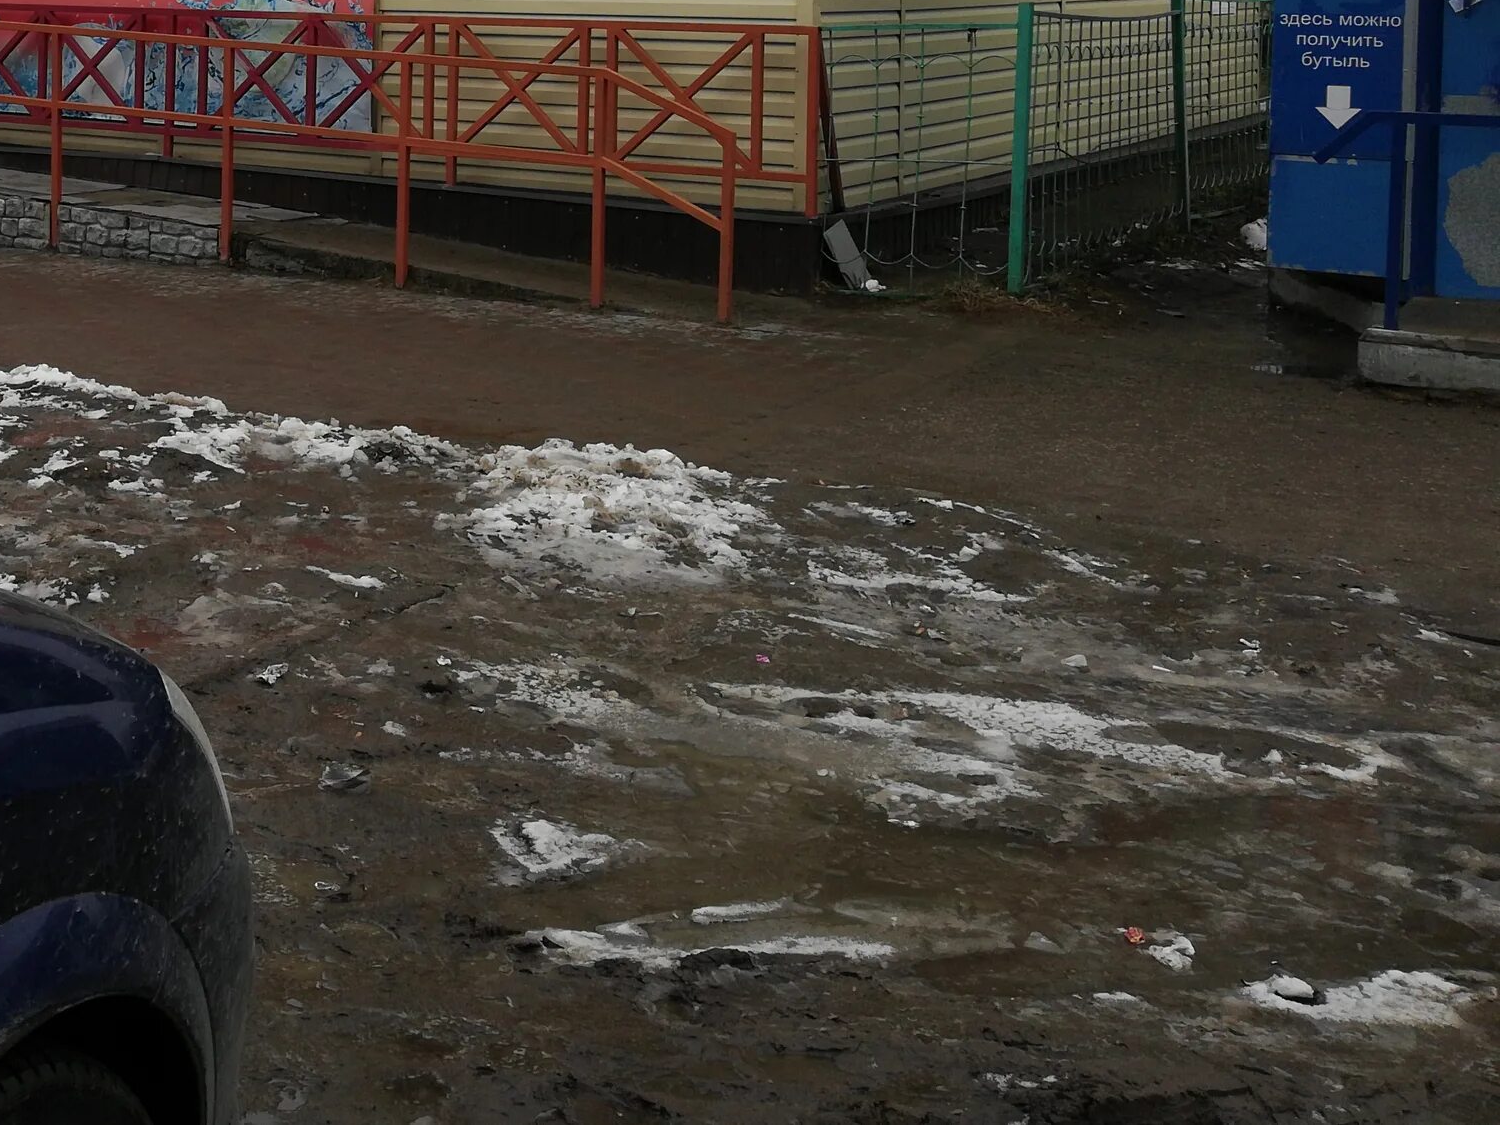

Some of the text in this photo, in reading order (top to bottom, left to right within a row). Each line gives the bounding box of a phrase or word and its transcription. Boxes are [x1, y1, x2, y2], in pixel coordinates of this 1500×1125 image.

[1279, 14, 1402, 28] здесь можно
[1296, 34, 1384, 50] получить
[1301, 51, 1370, 70] бутыль
